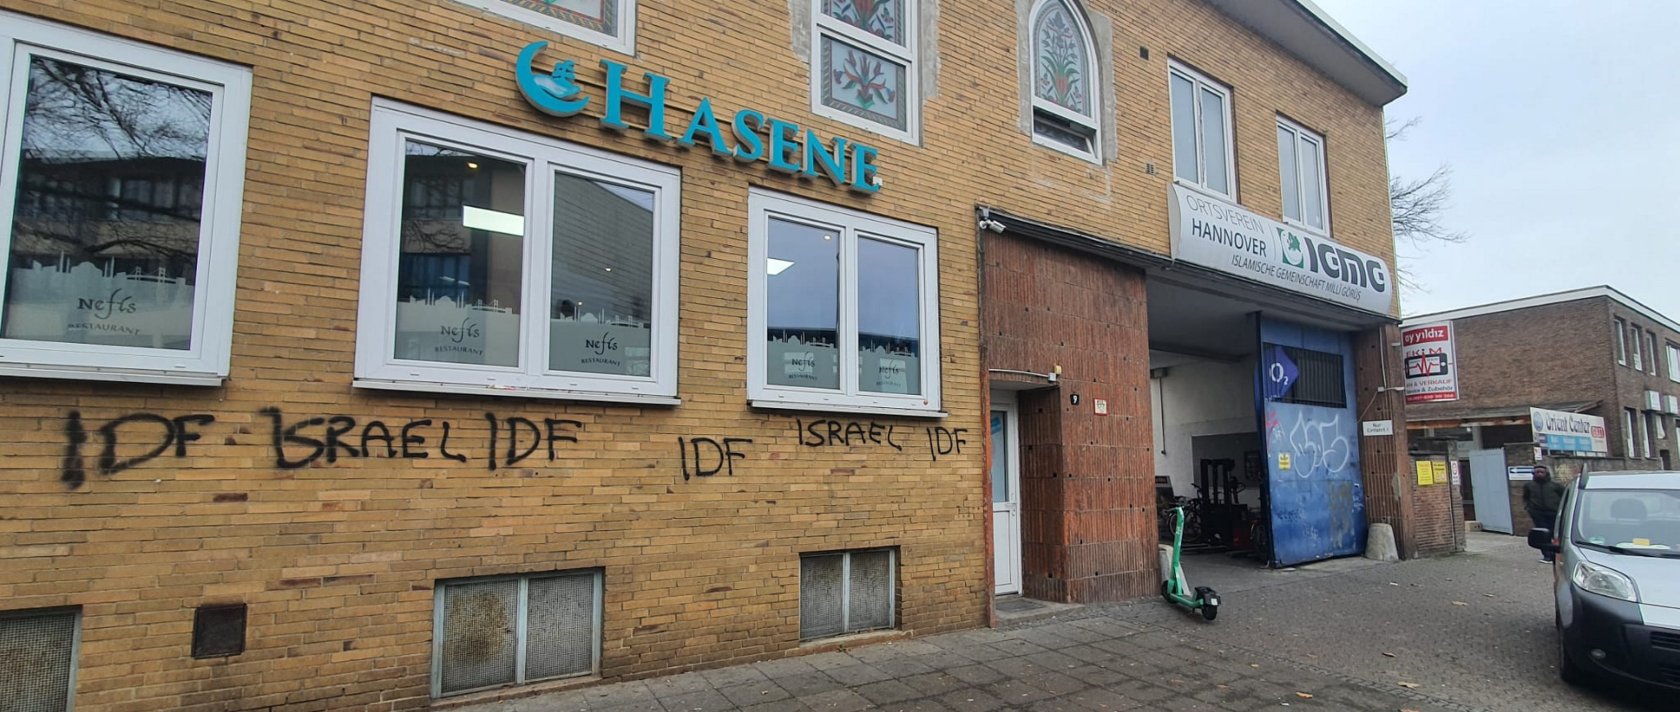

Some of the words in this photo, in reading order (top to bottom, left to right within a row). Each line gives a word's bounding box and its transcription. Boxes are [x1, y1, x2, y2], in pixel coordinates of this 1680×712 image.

[1186, 194, 1265, 235] ORTSVEREIN
[1191, 217, 1267, 258] HANNOVER
[1231, 254, 1276, 278] ISLAMISCHE
[1275, 266, 1326, 291] GEMEINSCHAFT
[1303, 236, 1385, 293] IGMG
[77, 287, 137, 320] Nefis
[67, 322, 141, 336] RESTAURANT
[440, 316, 480, 343] Nefis
[585, 331, 619, 356] Nefis
[434, 345, 484, 356] RESTAURANT
[580, 357, 621, 367] RESTAURANT
[791, 351, 816, 372] Nefis
[1073, 395, 1078, 404] 9
[61, 410, 215, 489] IDF
[260, 407, 467, 469] ISRAEL
[485, 412, 582, 471] IDF
[796, 418, 902, 451] ISRAEL
[927, 426, 968, 461] IDF
[678, 436, 753, 481] IDF
